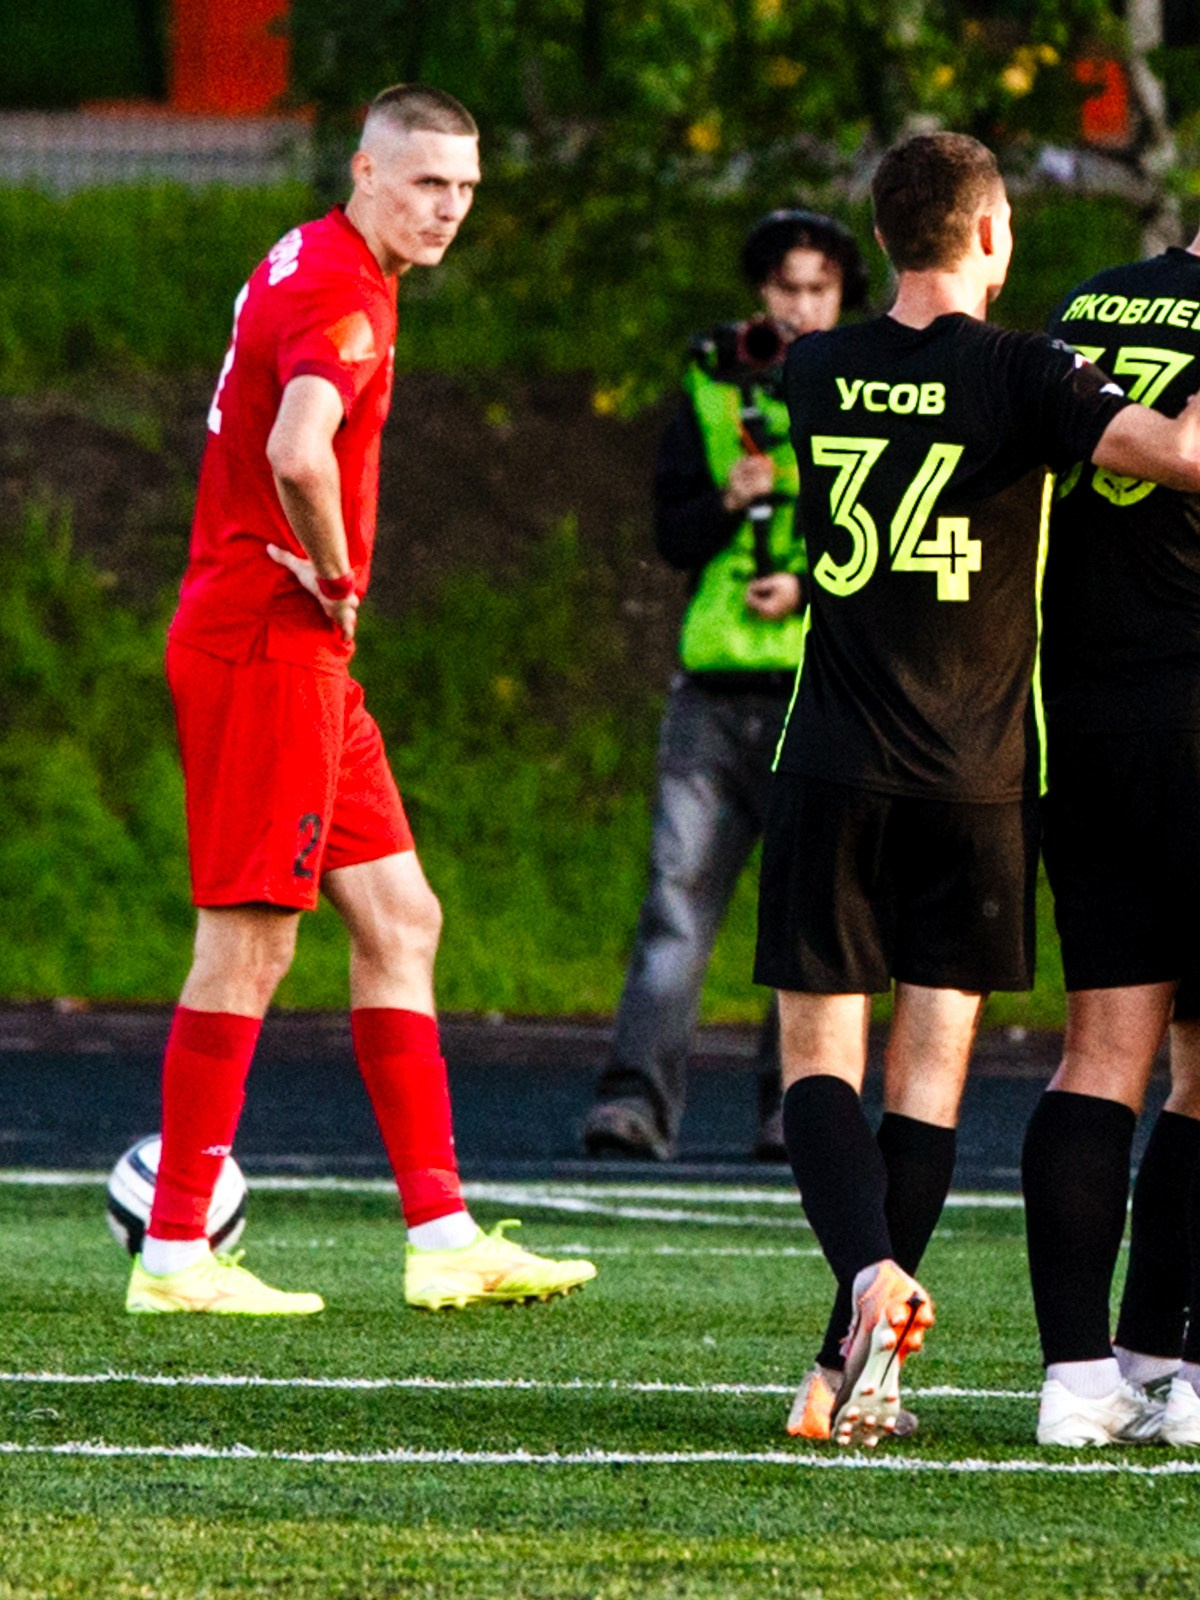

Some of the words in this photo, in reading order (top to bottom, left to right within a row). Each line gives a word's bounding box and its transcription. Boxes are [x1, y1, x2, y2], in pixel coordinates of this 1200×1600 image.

[834, 376, 946, 416] УСОВ
[810, 435, 982, 602] 34
[293, 813, 322, 879] 2
